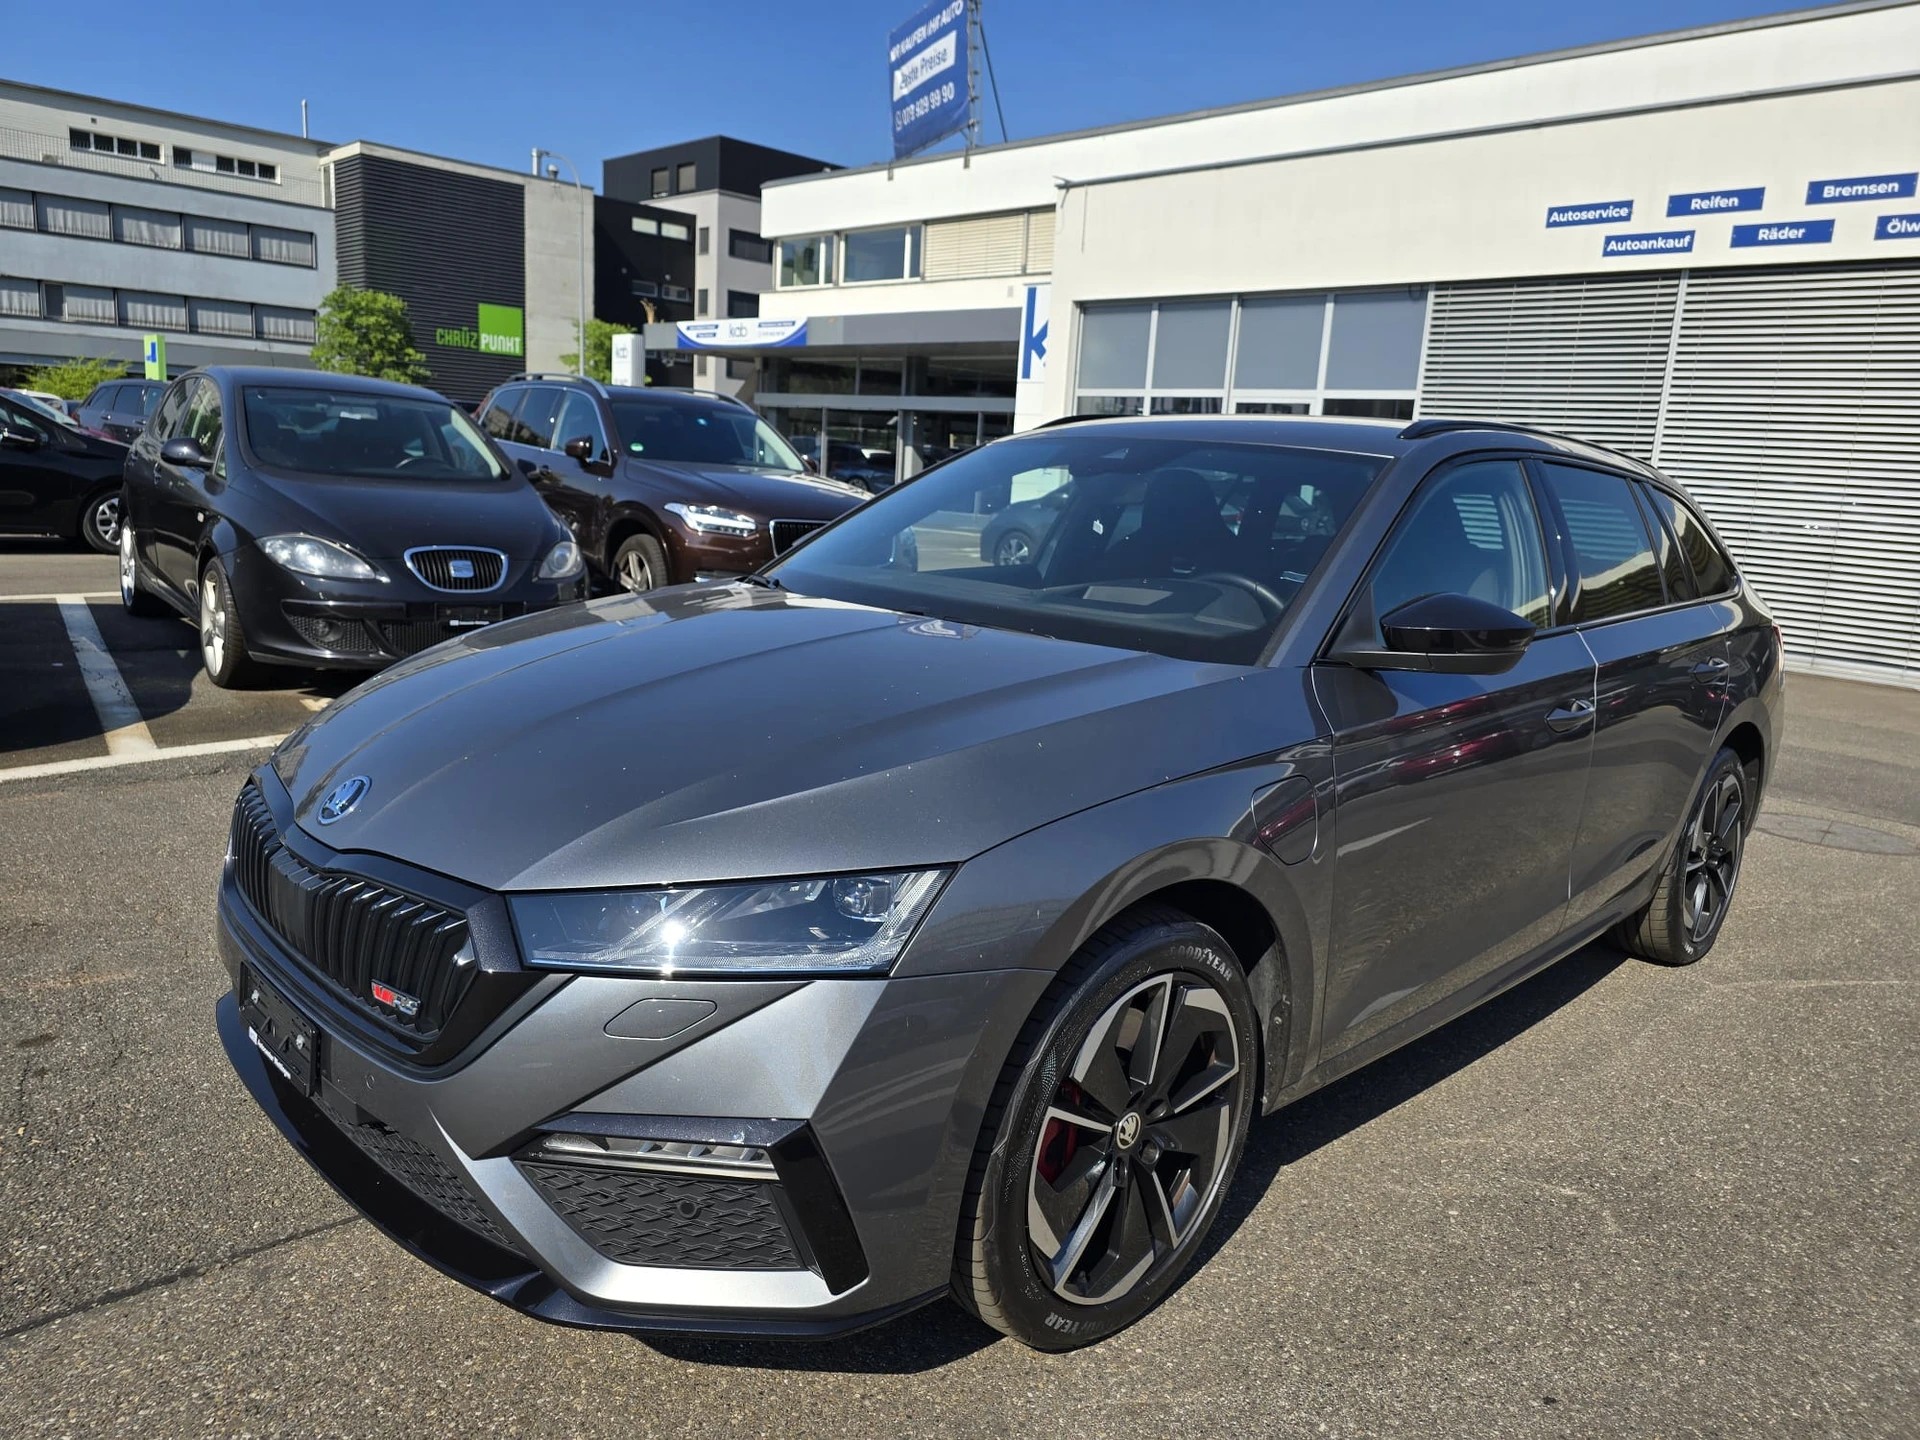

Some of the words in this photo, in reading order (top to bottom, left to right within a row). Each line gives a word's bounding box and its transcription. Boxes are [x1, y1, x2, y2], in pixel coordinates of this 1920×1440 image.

[940, 0, 964, 28] AUTO
[920, 48, 948, 76] Preise
[942, 82, 955, 103] 90
[1822, 182, 1900, 198] Bremsen
[1690, 195, 1739, 210] Reifen
[1549, 206, 1629, 223] Autoservice
[1758, 227, 1805, 241] Räder
[1606, 235, 1691, 252] Autoankauf
